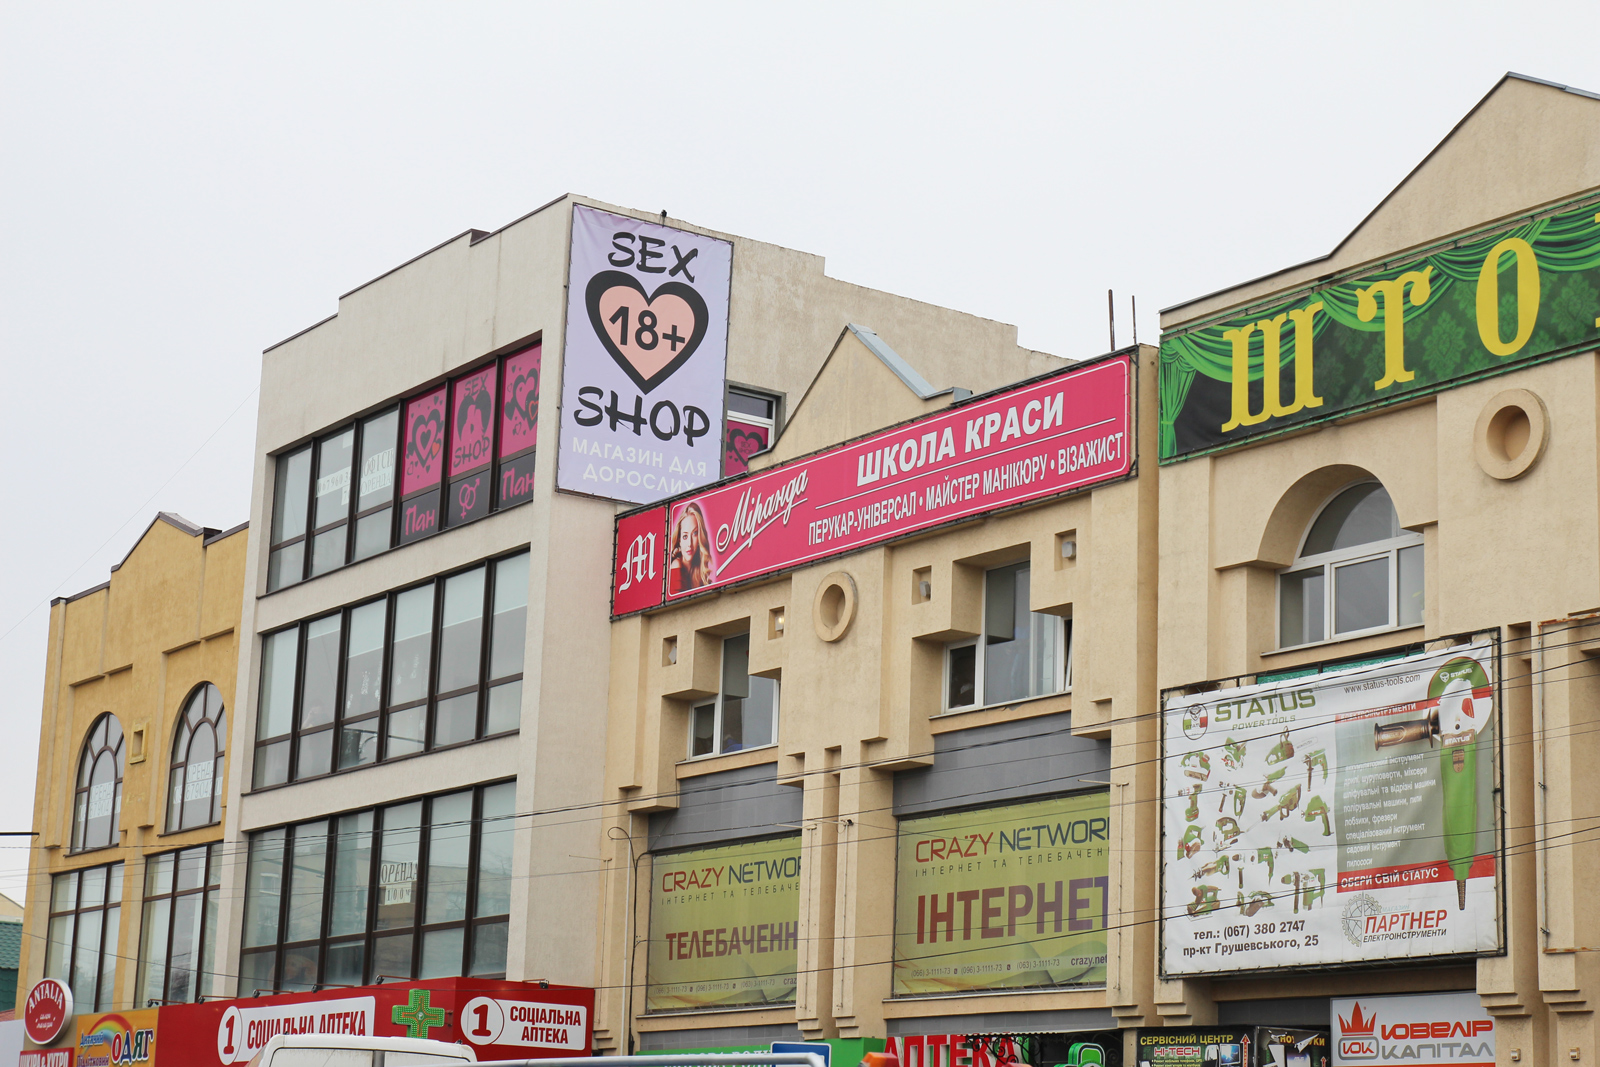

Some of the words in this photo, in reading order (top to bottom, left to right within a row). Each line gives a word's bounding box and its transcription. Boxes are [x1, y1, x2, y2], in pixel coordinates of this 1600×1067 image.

[608, 231, 698, 283] SEX
[609, 305, 686, 352] 18+
[1221, 213, 1600, 433] ШТО
[464, 373, 489, 397] SEX
[573, 386, 710, 447] SHOP
[453, 435, 491, 468] SHOP
[856, 427, 956, 487] ШКОЛА
[964, 392, 1065, 453] КРАСИ
[572, 437, 663, 468] МАГАЗИН
[669, 456, 707, 477] ДЛЯ
[808, 491, 917, 546] ПЕРУКАР-УНІВЕРСАЛ
[926, 475, 979, 511] МАЙСТЕР
[982, 459, 1047, 496] МАНІКЮРУ
[1058, 431, 1123, 474] ВІЗАЖИСТ
[405, 505, 435, 536] Пан
[716, 469, 808, 553] Міранда
[1344, 674, 1421, 694] www.status-tools.com
[1215, 688, 1316, 723] STATUS
[915, 831, 994, 863] CRAZY
[1000, 816, 1110, 853] NETWOR
[915, 861, 982, 877] ІНТЕРНЕТ
[993, 859, 1007, 869] ТА
[1019, 846, 1110, 866] ТЕЛЕБАЧЕН
[662, 866, 724, 893] CRAZY
[1340, 875, 1373, 888] ОБЕРИ
[1375, 869, 1400, 884] СВІЙ
[1402, 867, 1439, 882] СТАТУС
[662, 892, 715, 906] ІНТЕРНЕТ
[723, 890, 734, 899] ТА
[916, 875, 1108, 944] ІНТЕРНЕТ
[1193, 930, 1220, 940] тел.:
[1223, 925, 1250, 941] (067)
[1254, 923, 1276, 935] 380
[1280, 920, 1305, 933] 2747
[1363, 929, 1447, 943] ЕЛЕКТРОІНСТРУМЕНТИ
[1365, 909, 1447, 935] ПАРТНЕР
[665, 921, 798, 961] ТЕЛЕБАЧЕНН
[1183, 945, 1211, 958] пр-кт
[1215, 939, 1300, 956] Грушевського,
[1304, 935, 1319, 946] 25
[28, 983, 63, 1014] ANTALIA
[472, 1004, 492, 1037] 1
[510, 1006, 581, 1026] СОЦІАЛЬНА
[112, 1028, 154, 1066] ОДЯГ
[223, 1015, 235, 1054] 1
[521, 1026, 568, 1044] АПТЕКА
[1140, 1033, 1196, 1045] СЕРВІСНИЙ
[1200, 1034, 1233, 1045] ЦЕНТР
[1154, 1046, 1201, 1057] HI-TECH
[1382, 1042, 1494, 1060] КАПІТАЛ
